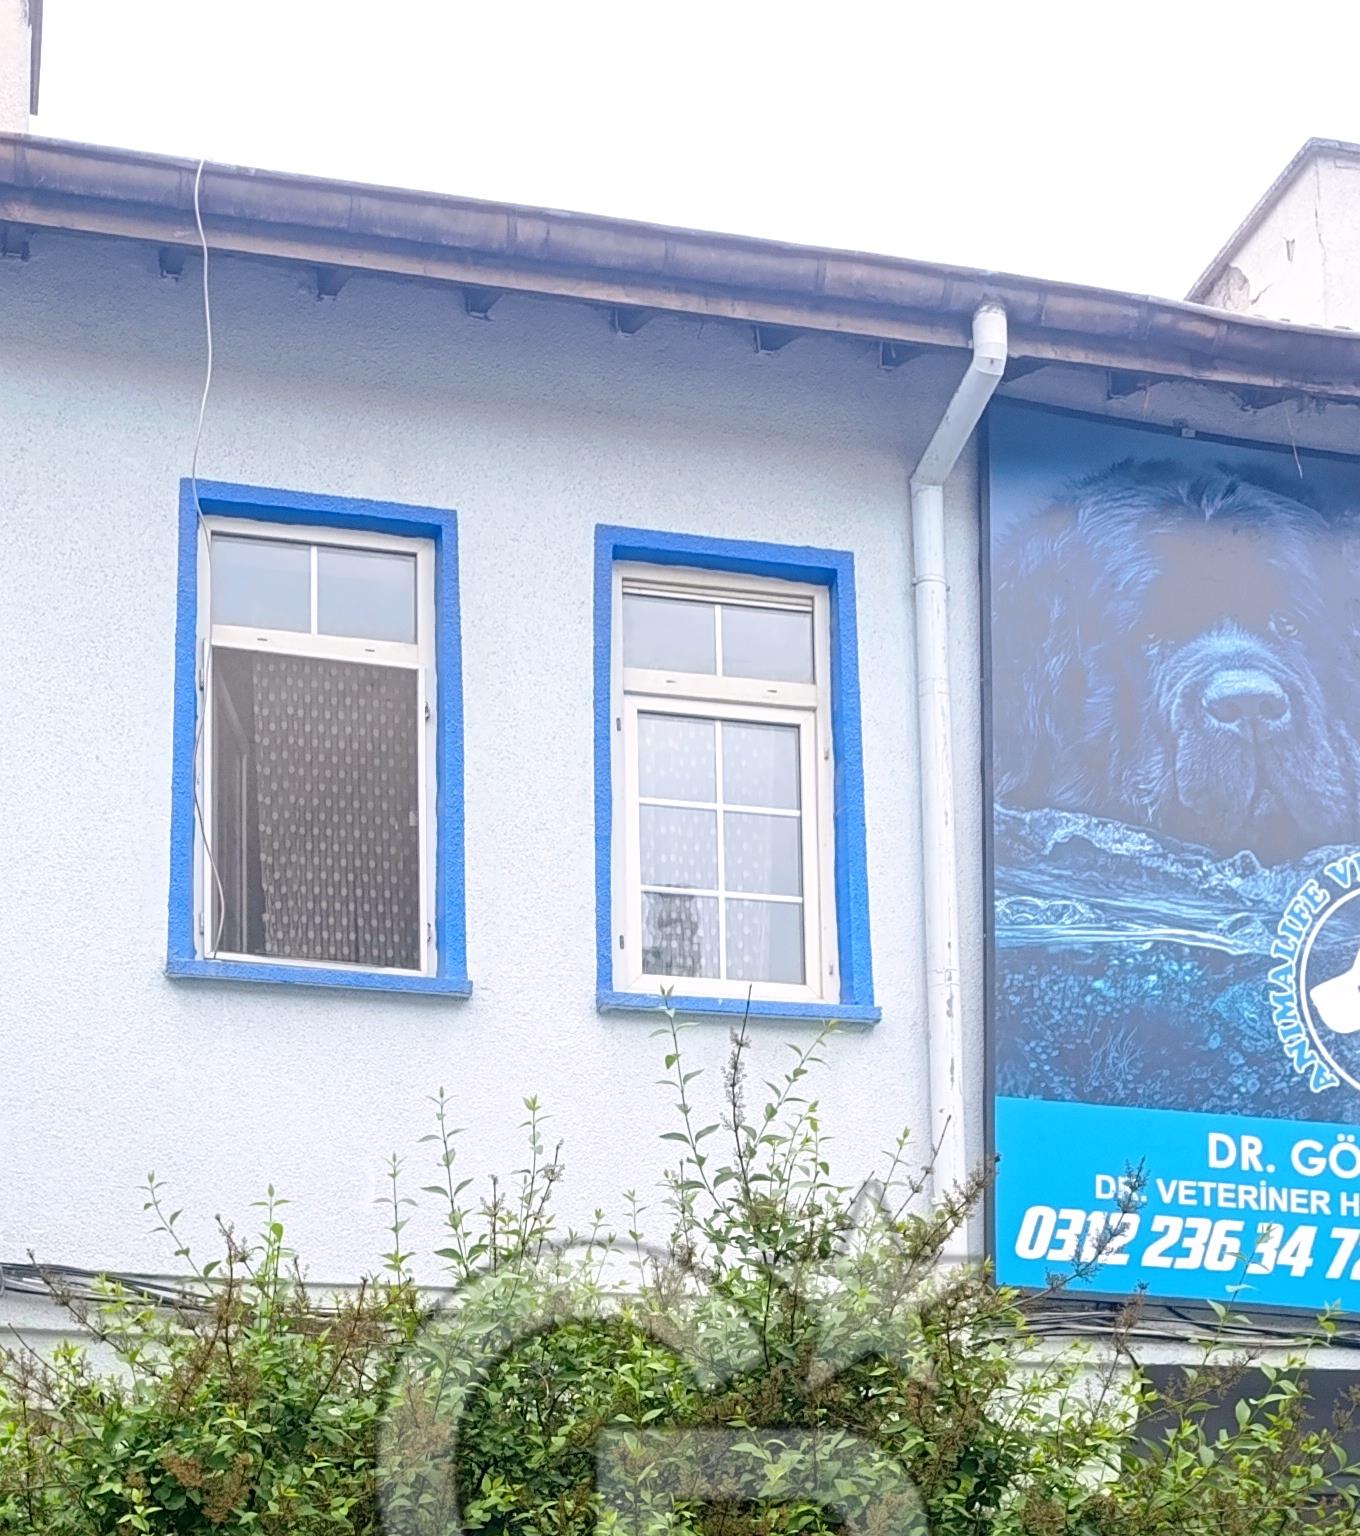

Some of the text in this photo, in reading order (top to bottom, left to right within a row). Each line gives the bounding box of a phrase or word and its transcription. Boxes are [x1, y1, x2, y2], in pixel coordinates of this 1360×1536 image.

[1268, 879, 1340, 1092] ANIMALIFE
[1208, 1132, 1276, 1173] DR.
[1156, 1178, 1332, 1216] VETERİNER
[1015, 1206, 1140, 1266] 0312
[1141, 1215, 1244, 1272] 236
[1246, 1222, 1318, 1278] 34
